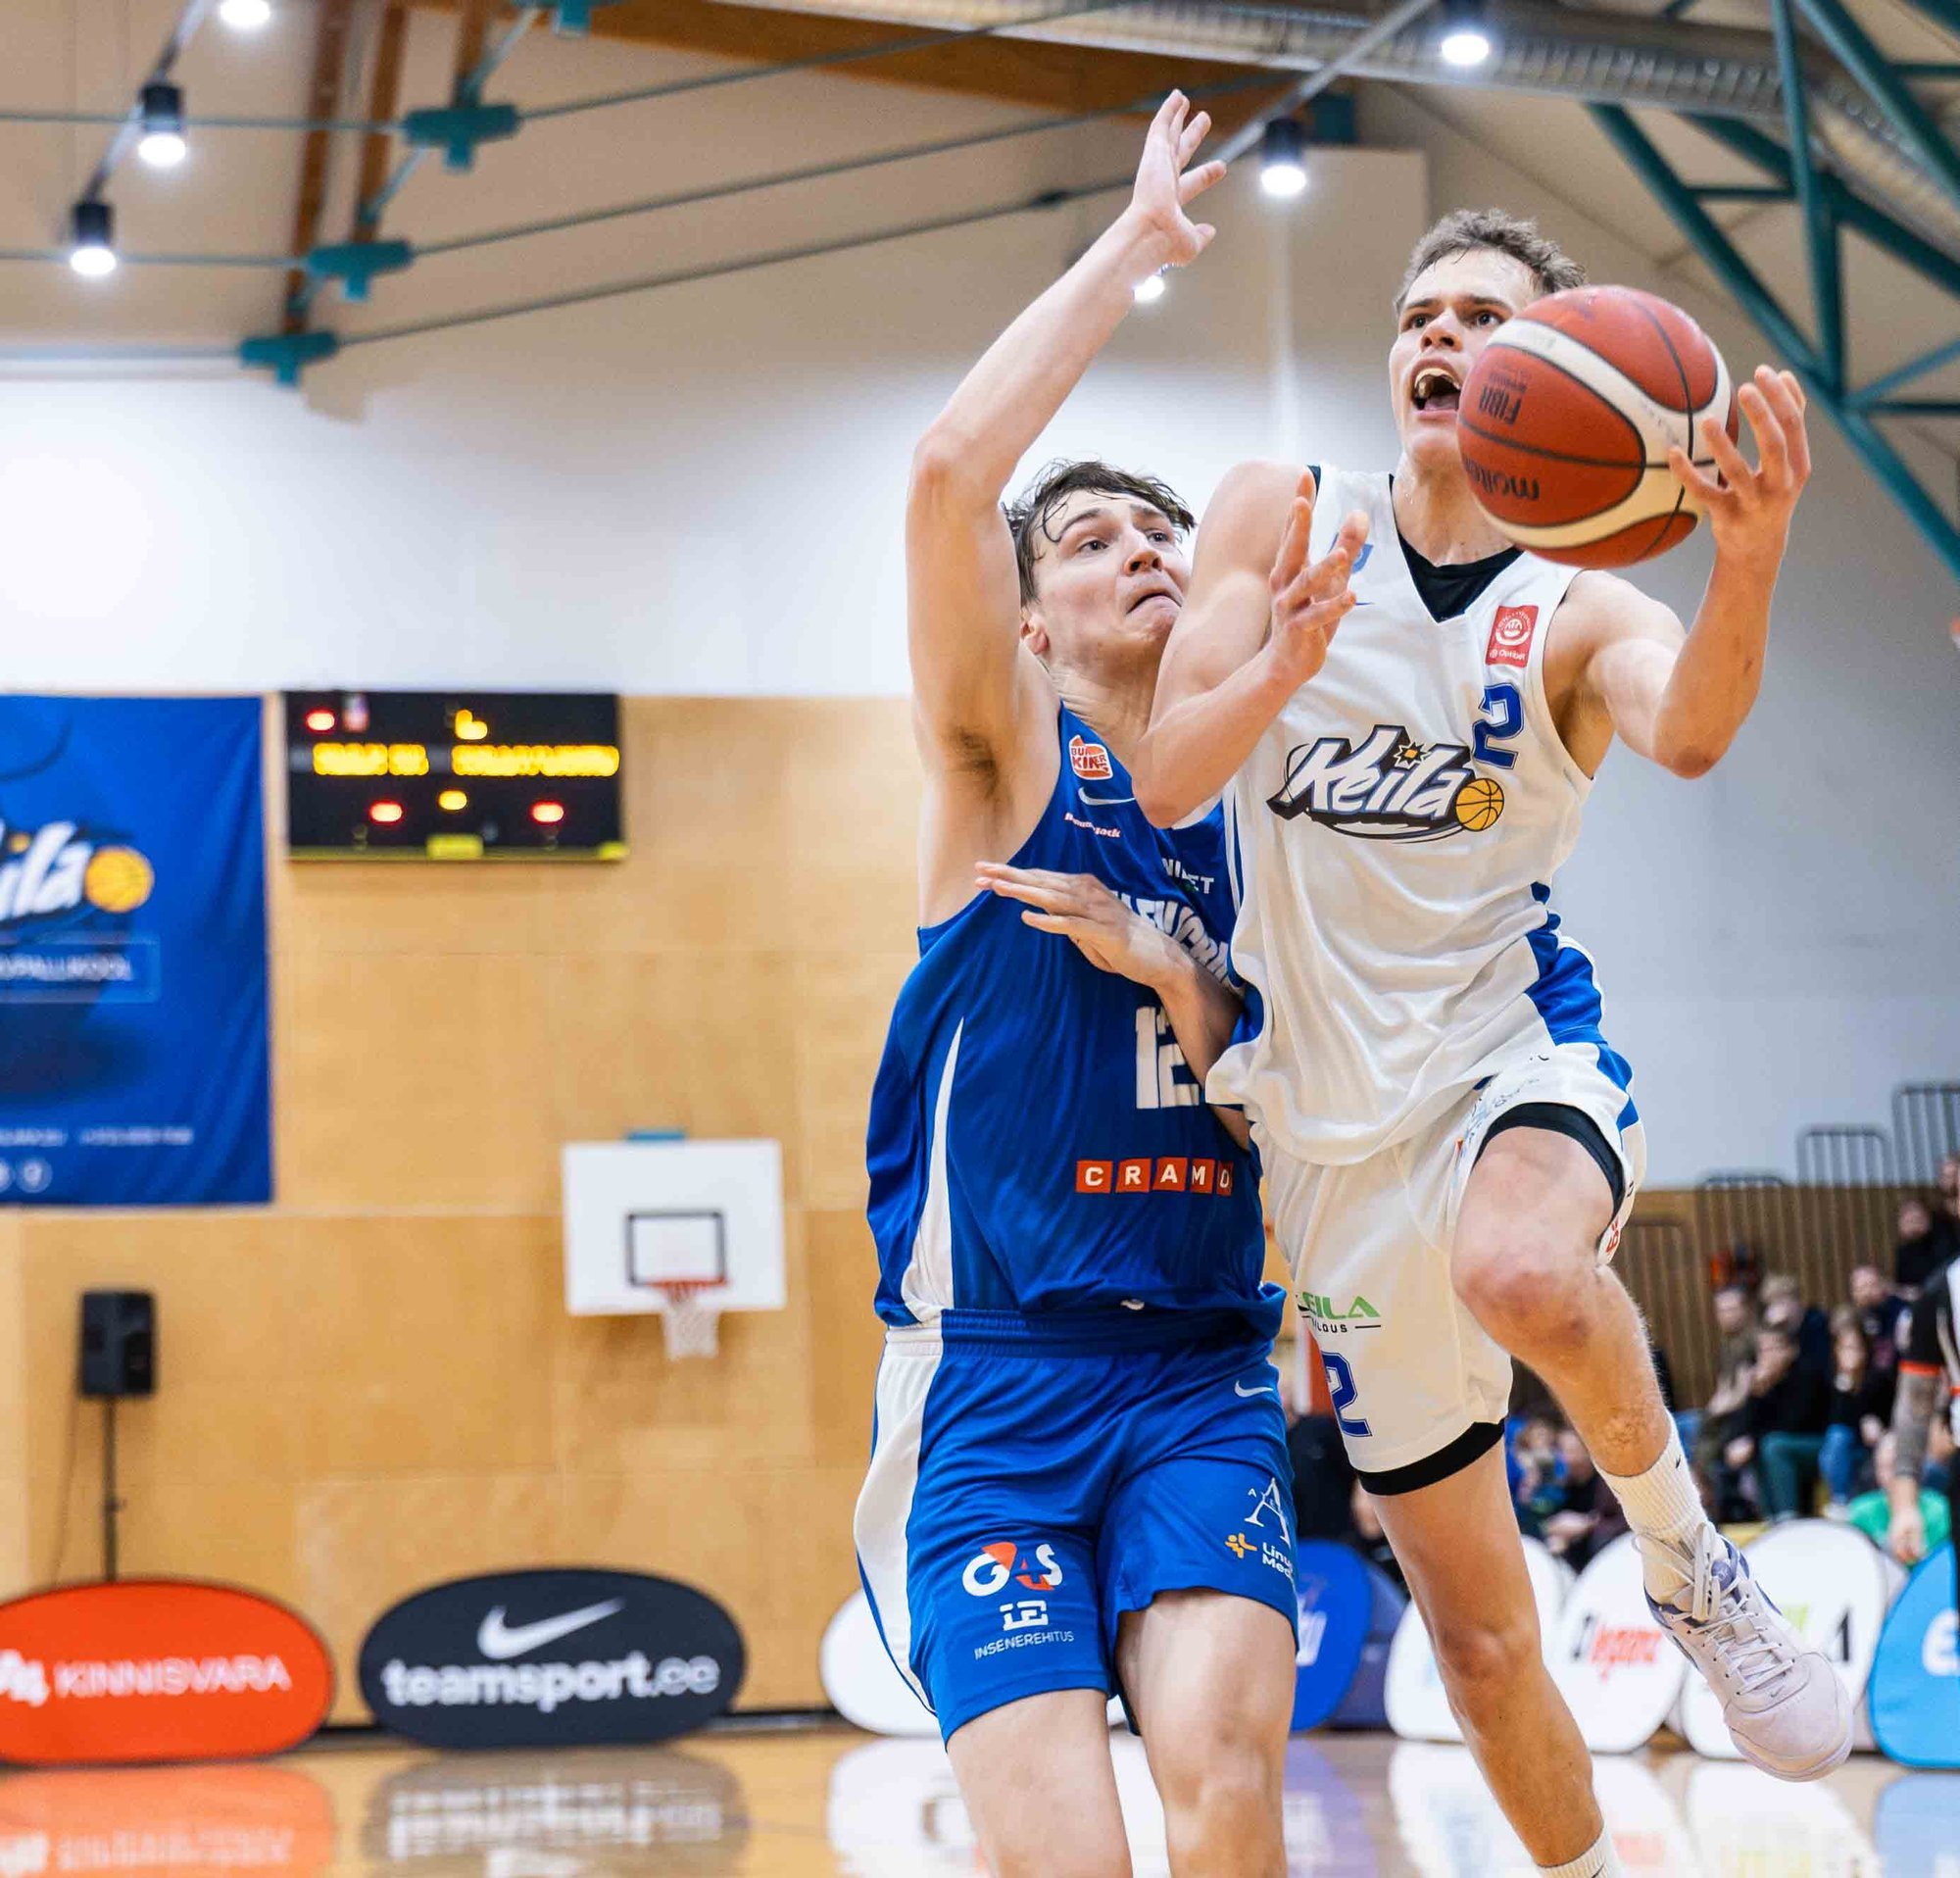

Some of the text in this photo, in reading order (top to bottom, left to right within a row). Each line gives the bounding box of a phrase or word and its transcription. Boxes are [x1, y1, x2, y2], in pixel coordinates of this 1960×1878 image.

[1471, 682, 1525, 770] 2
[1267, 723, 1478, 826] Keila
[1084, 1163, 1230, 1189] CRAMO
[1321, 1350, 1373, 1437] 2
[962, 1542, 1063, 1597] G4S
[974, 1631, 1074, 1659] INSENEREHITUS
[53, 1655, 293, 1698] KINNISVARA
[381, 1652, 719, 1712] teamsport.ee
